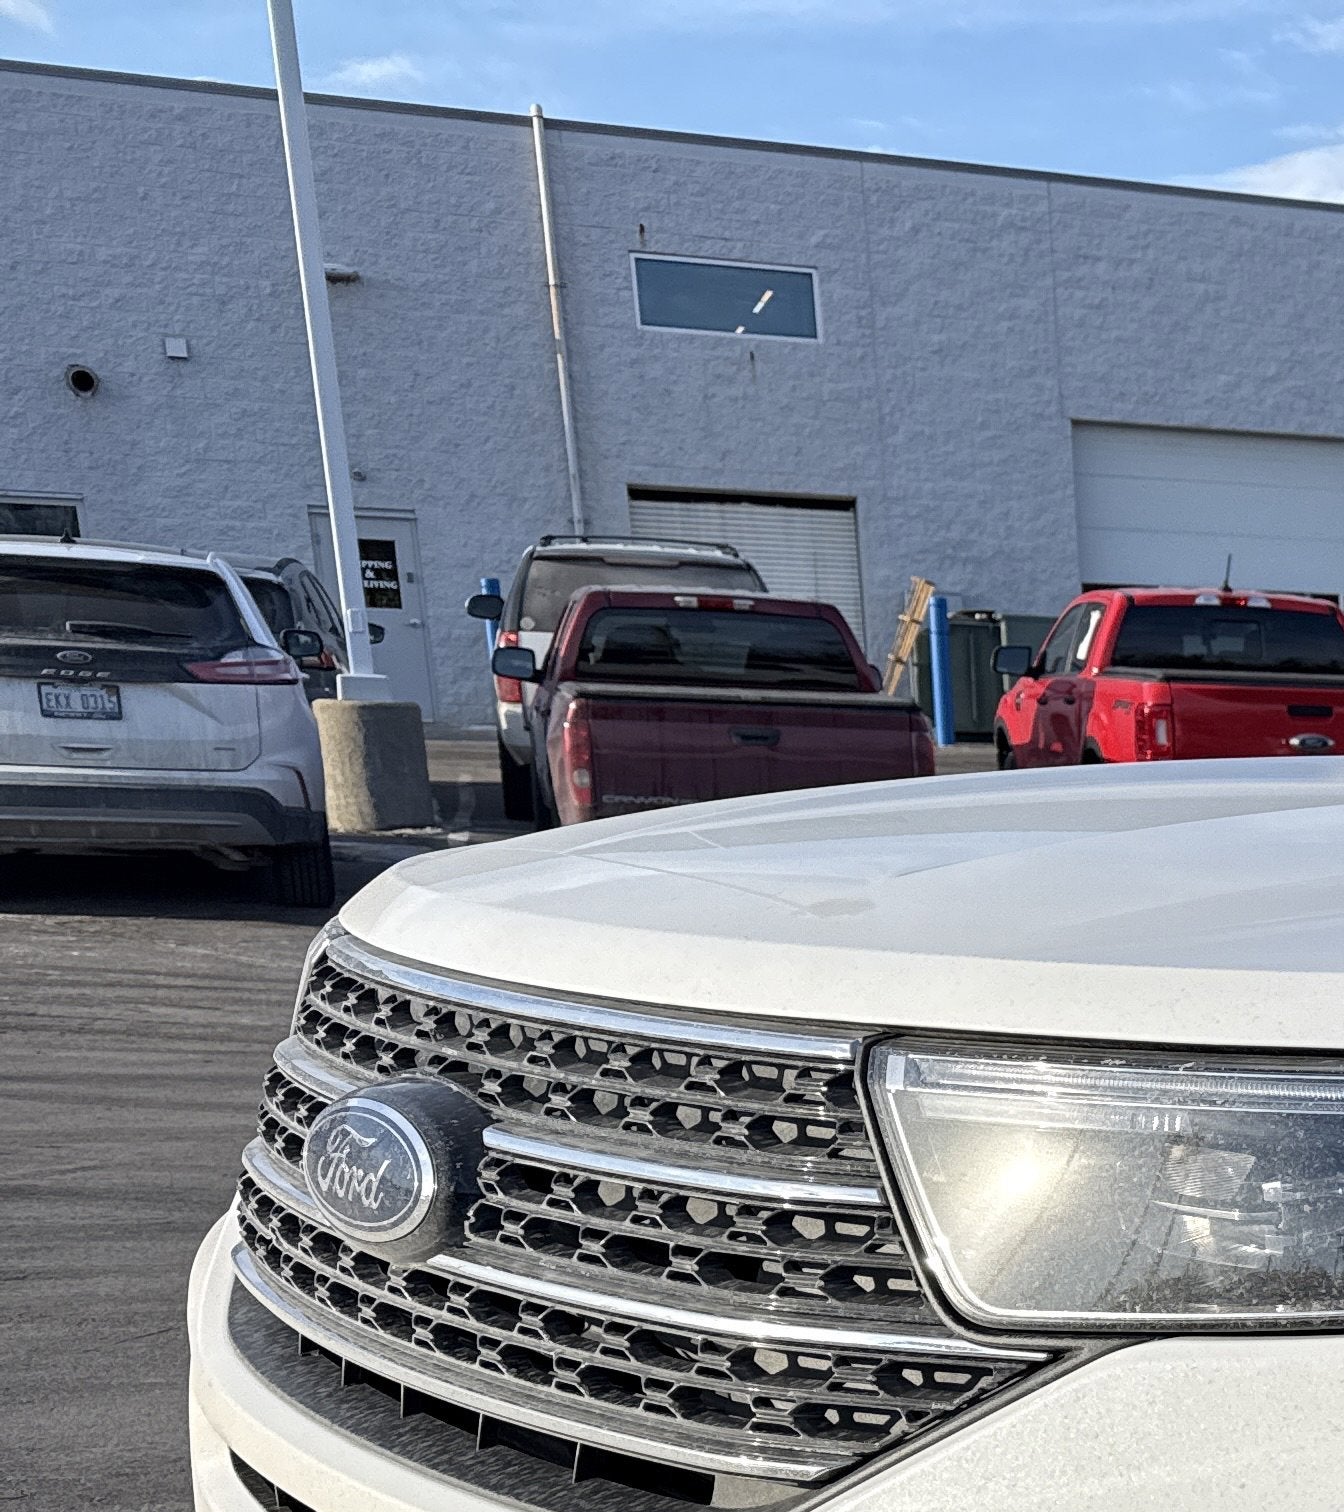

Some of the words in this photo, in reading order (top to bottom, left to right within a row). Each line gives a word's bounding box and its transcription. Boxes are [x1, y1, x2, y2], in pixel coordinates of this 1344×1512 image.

[364, 568, 376, 578] &
[40, 668, 111, 678] EDGE
[45, 692, 72, 710] EKX
[316, 1124, 393, 1210] Ford
